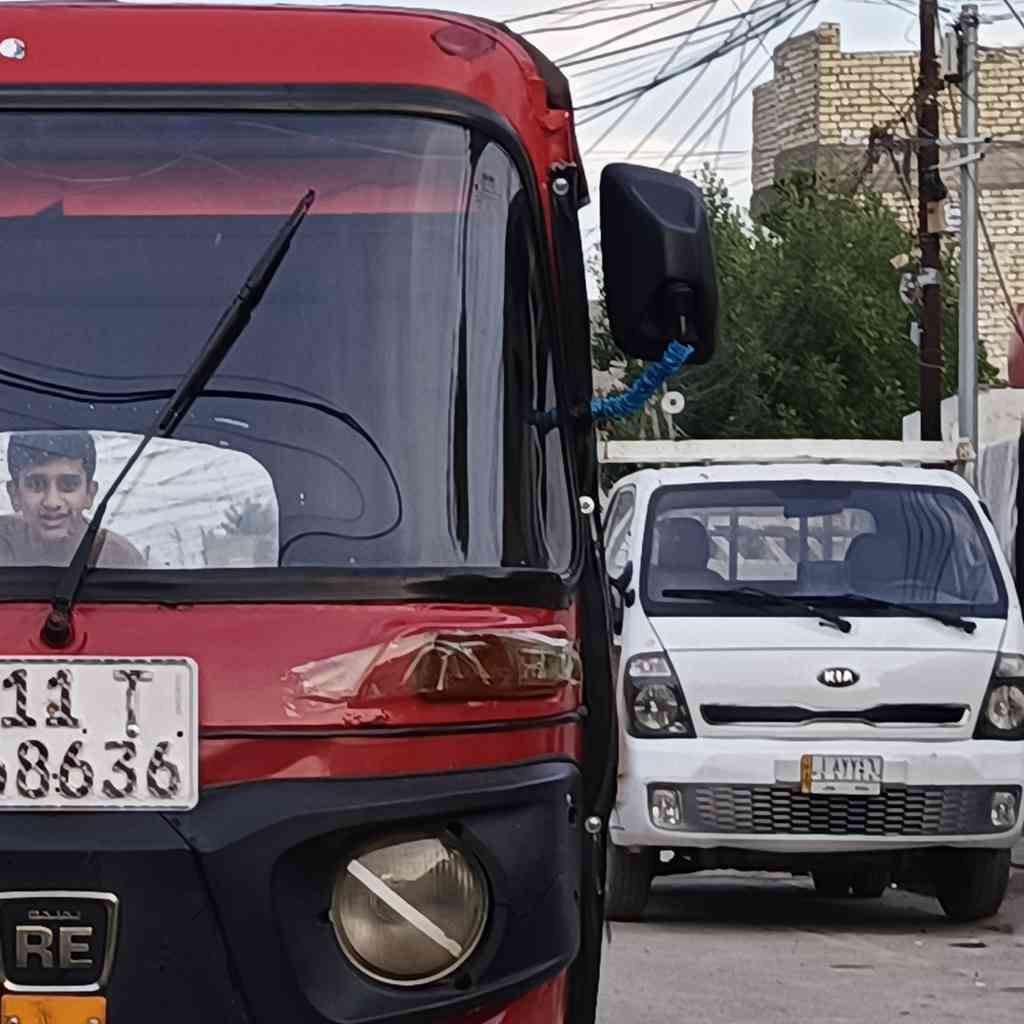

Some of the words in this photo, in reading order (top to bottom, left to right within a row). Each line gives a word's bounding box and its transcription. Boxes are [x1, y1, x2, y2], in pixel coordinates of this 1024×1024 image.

[1, 669, 79, 728] 11
[112, 670, 153, 728] T
[16, 925, 93, 968] RE
